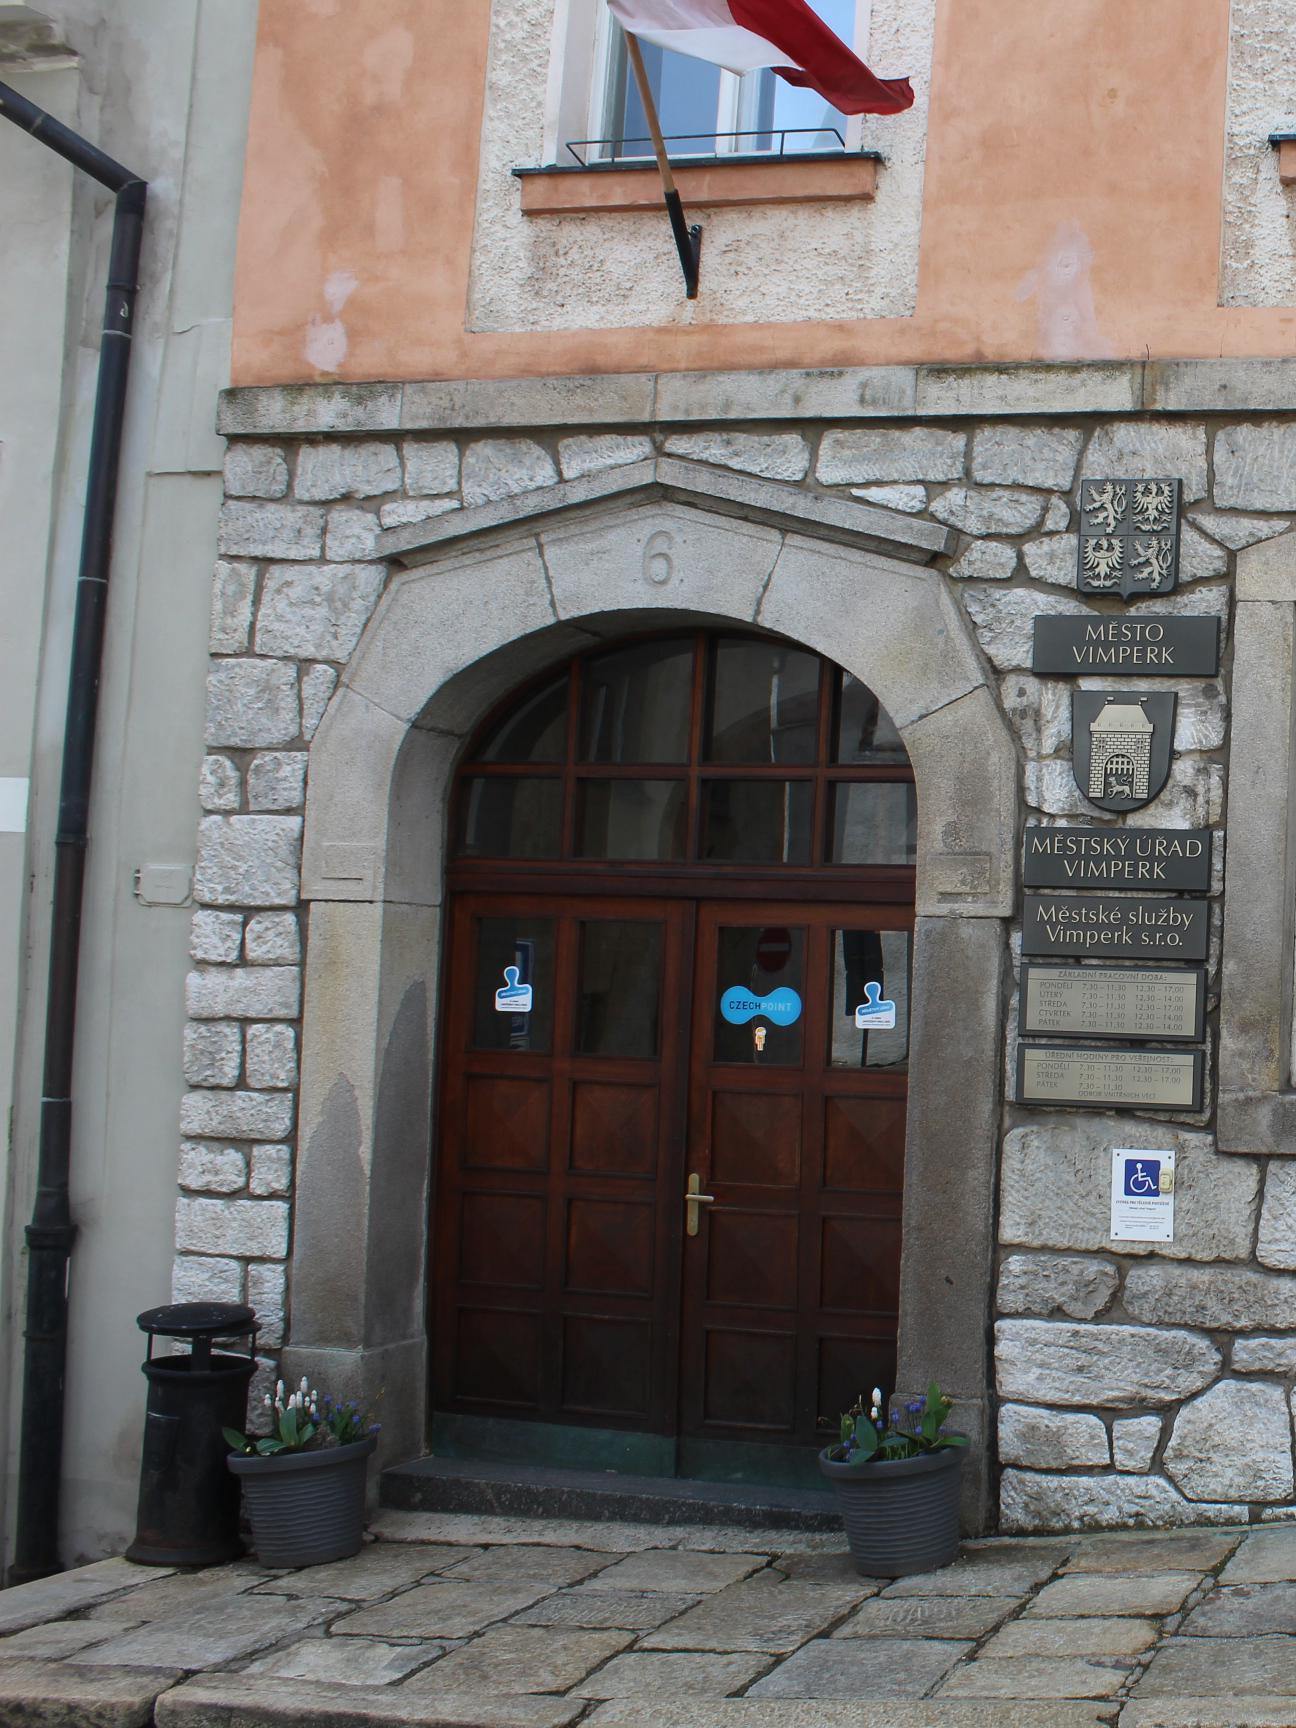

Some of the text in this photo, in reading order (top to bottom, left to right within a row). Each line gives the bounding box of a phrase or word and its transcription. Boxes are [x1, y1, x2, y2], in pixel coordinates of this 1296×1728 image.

[642, 530, 674, 588] 6
[1086, 621, 1164, 642] MĚSTO
[1073, 646, 1175, 664] VIMPERK
[1032, 834, 1202, 857] MĚSTSKÝ ÚŘAD
[1064, 860, 1167, 879] VIMPERK
[1036, 904, 1193, 930] Městské služby
[1046, 925, 1183, 947] Vimperk s.r.o.
[1058, 970, 1097, 978] ZÁKLADNÍ
[1099, 972, 1138, 980] PRACOVNÍ
[1077, 1053, 1108, 1061] HODINY
